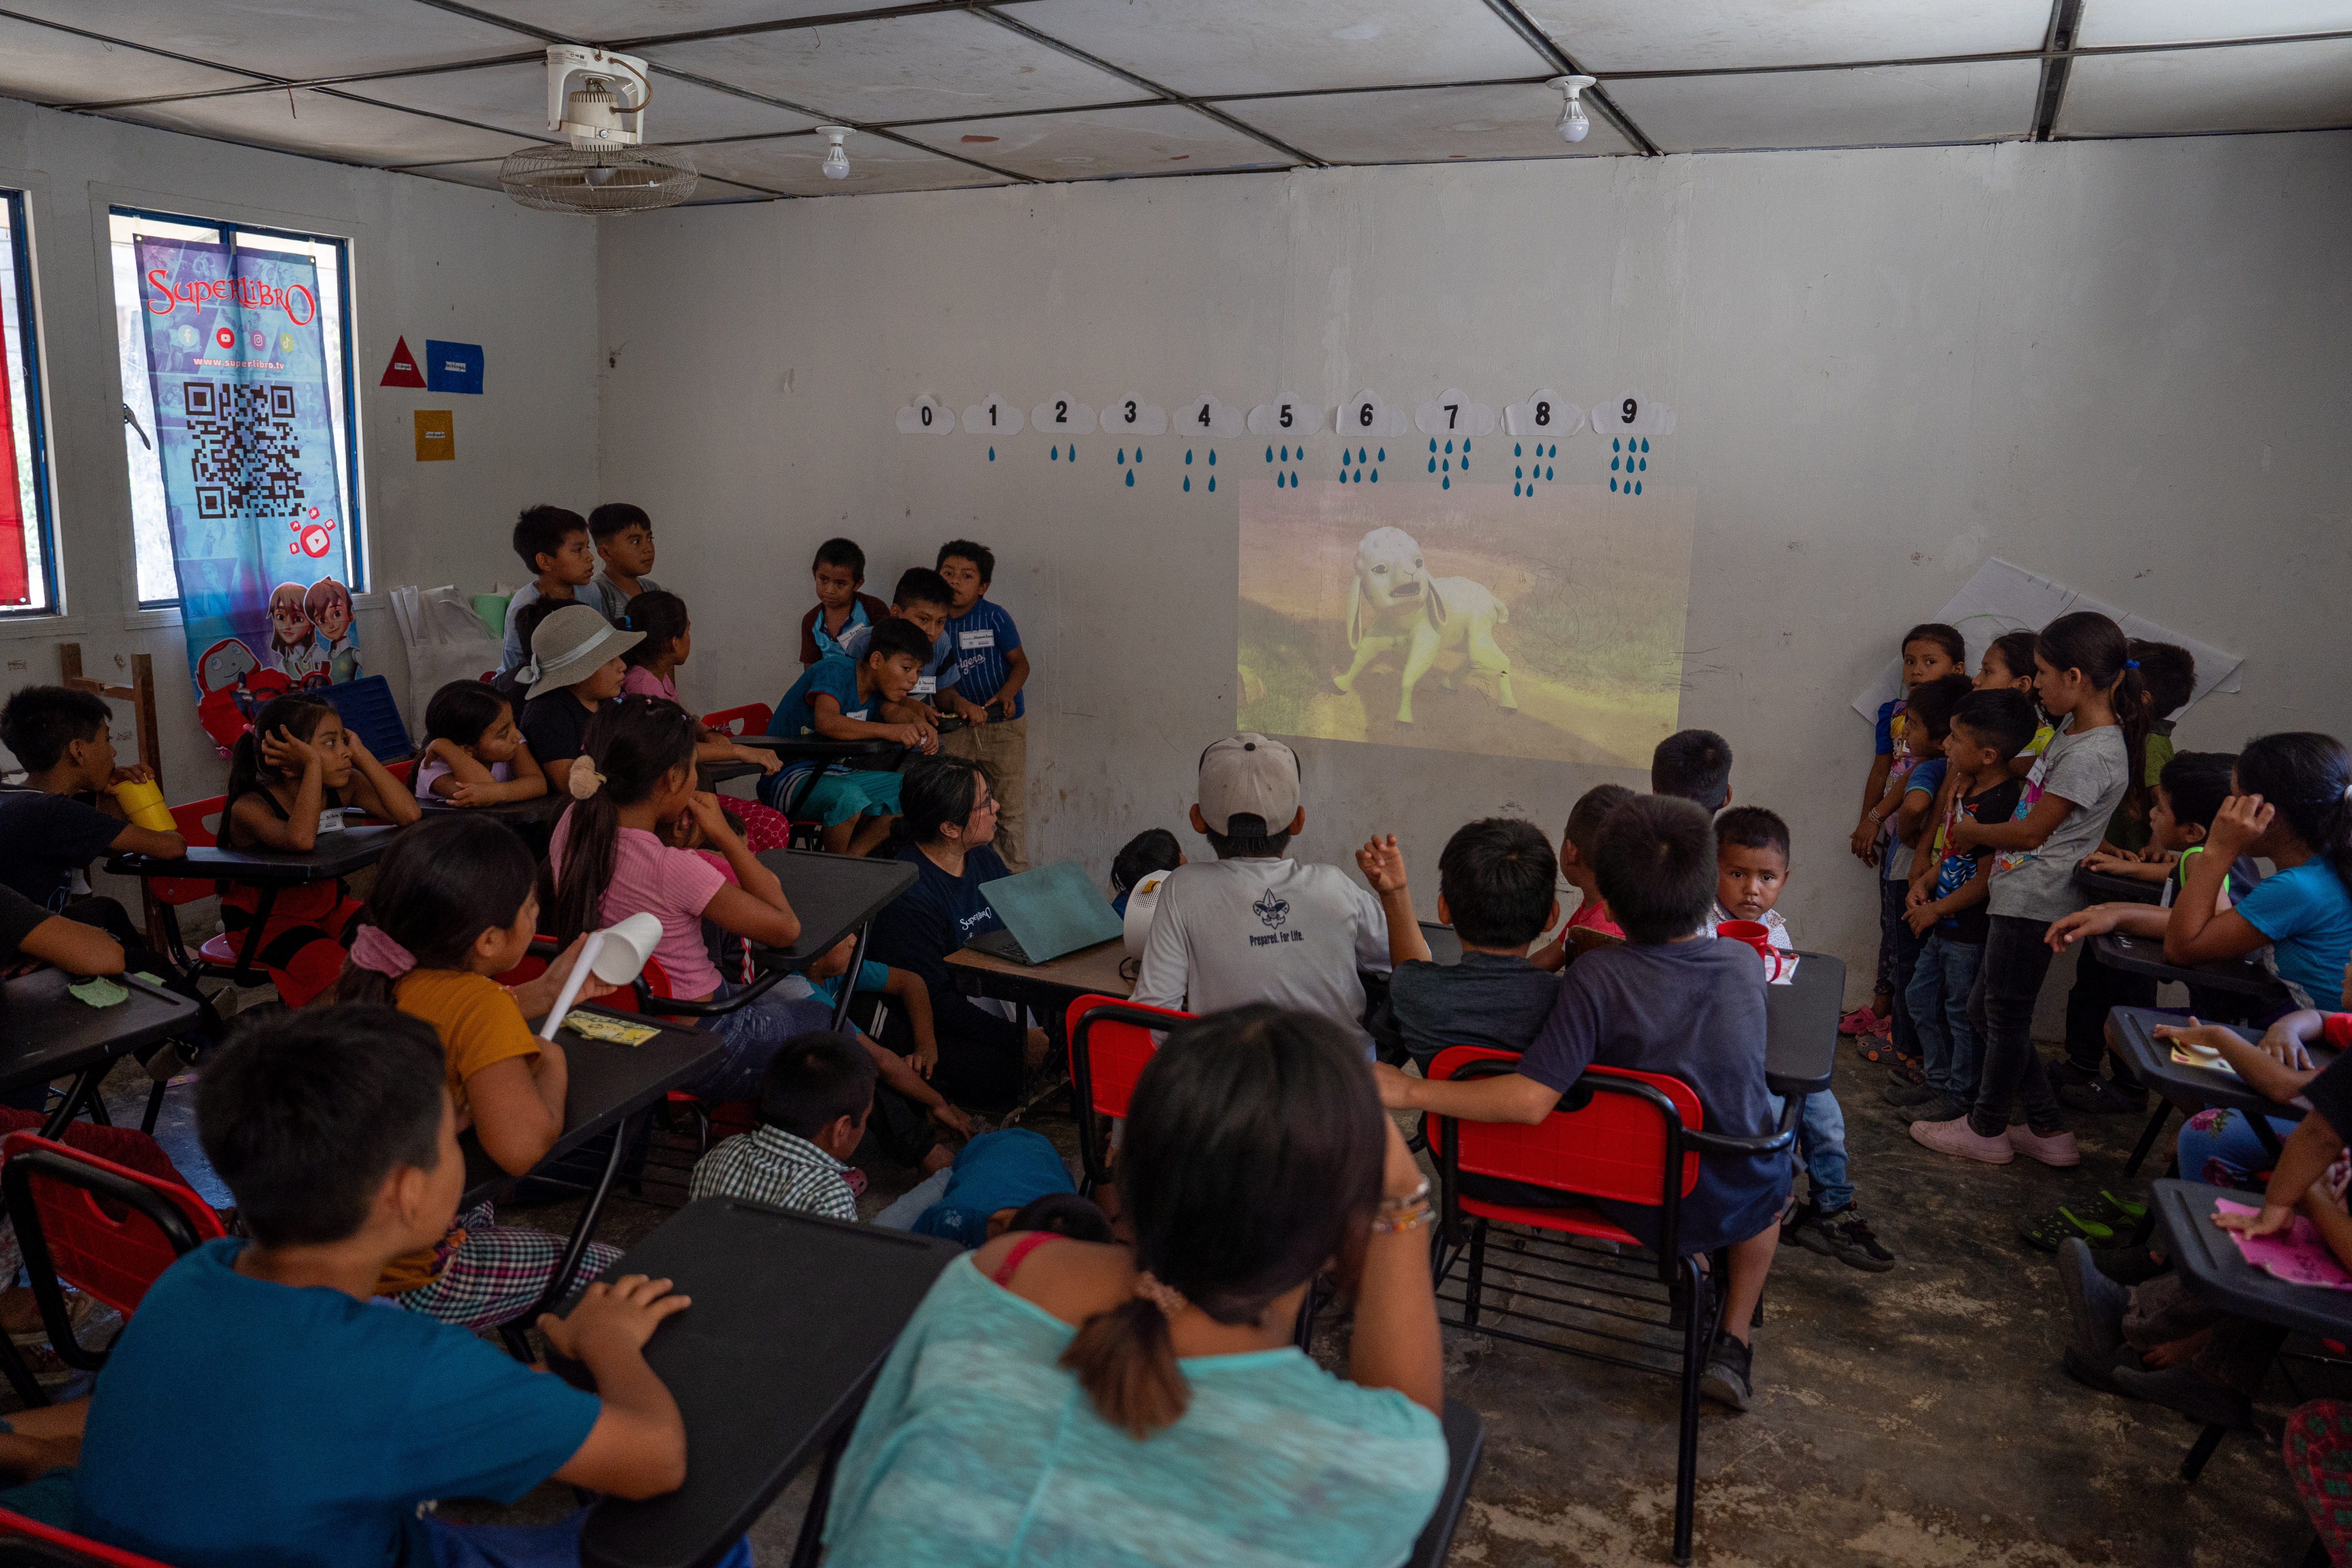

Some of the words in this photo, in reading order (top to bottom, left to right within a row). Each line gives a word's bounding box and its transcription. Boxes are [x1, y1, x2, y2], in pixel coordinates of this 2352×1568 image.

[193, 358, 284, 370] www.superlibro.tv
[922, 406, 932, 426] 0
[989, 404, 997, 426] 1
[1056, 401, 1067, 423] 2
[1124, 401, 1136, 423] 3
[1198, 404, 1210, 427] 4
[1280, 404, 1293, 427] 5
[1360, 403, 1373, 426] 6
[1444, 404, 1458, 429] 7
[1535, 401, 1550, 426] 8
[1621, 398, 1637, 423] 9
[960, 654, 986, 675] igers
[1249, 932, 1280, 947] Prepared.
[1280, 931, 1290, 943] For
[1291, 930, 1304, 941] Life.
